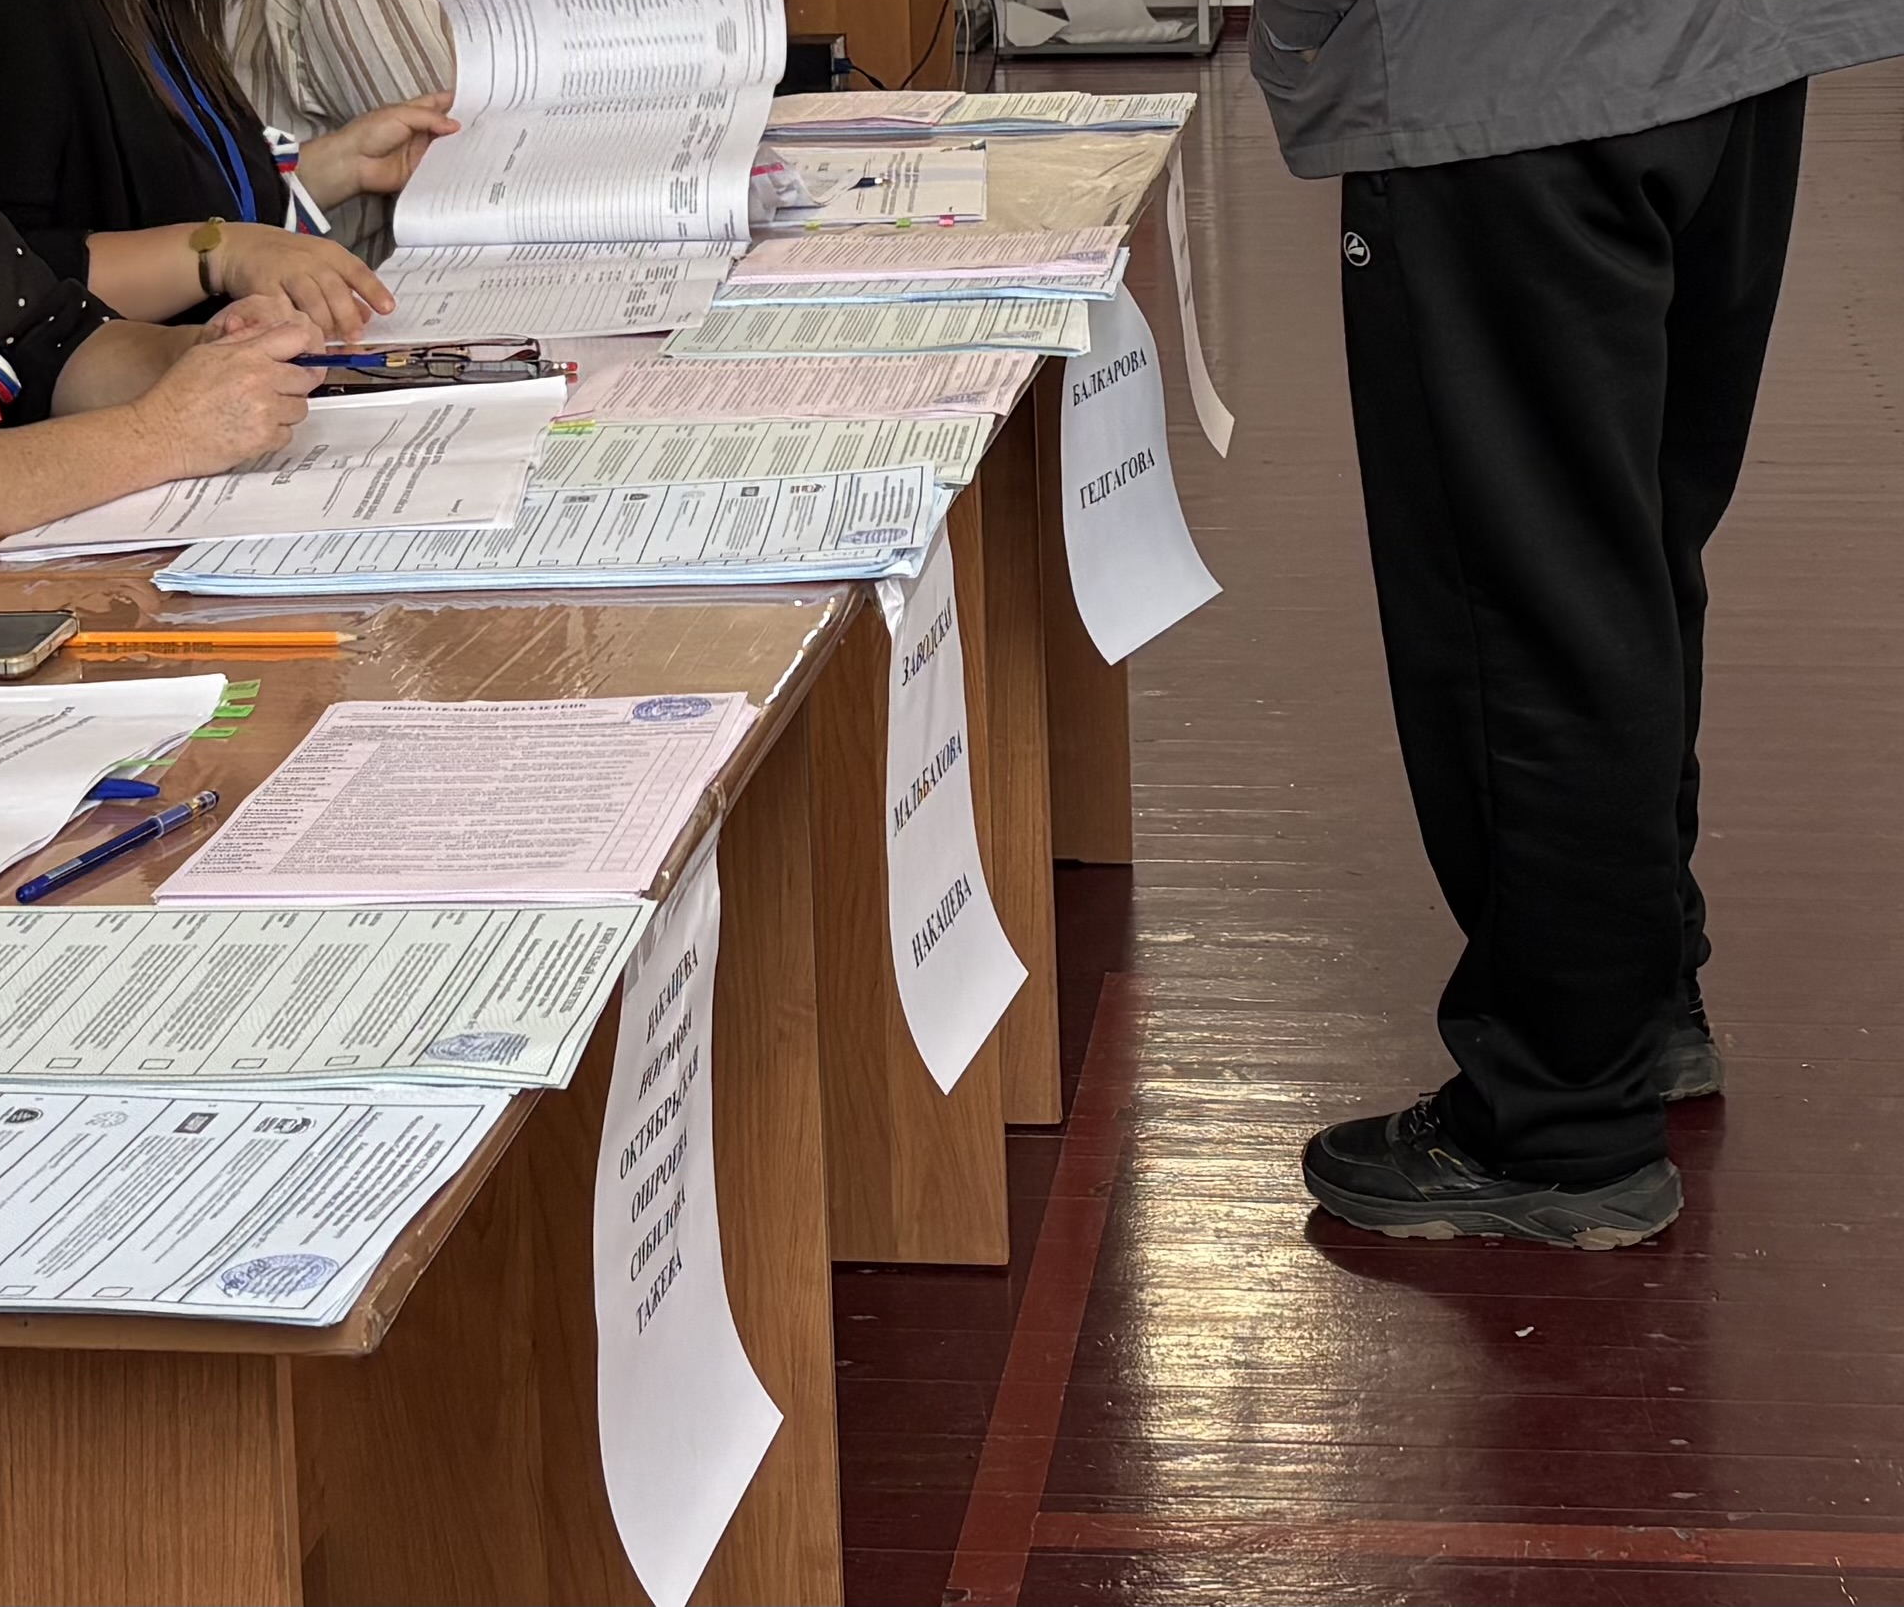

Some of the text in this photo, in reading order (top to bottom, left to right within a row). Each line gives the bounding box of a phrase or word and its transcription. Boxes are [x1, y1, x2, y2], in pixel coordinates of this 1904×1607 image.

[1072, 346, 1147, 407] БАЛКАРОВА
[1079, 447, 1155, 510] ГЕДГАГОВА
[893, 728, 963, 838] МАЛЬБАХОВА
[912, 872, 973, 970] НАКАЦЕВА
[635, 1247, 684, 1336] ТАЖЕВА
